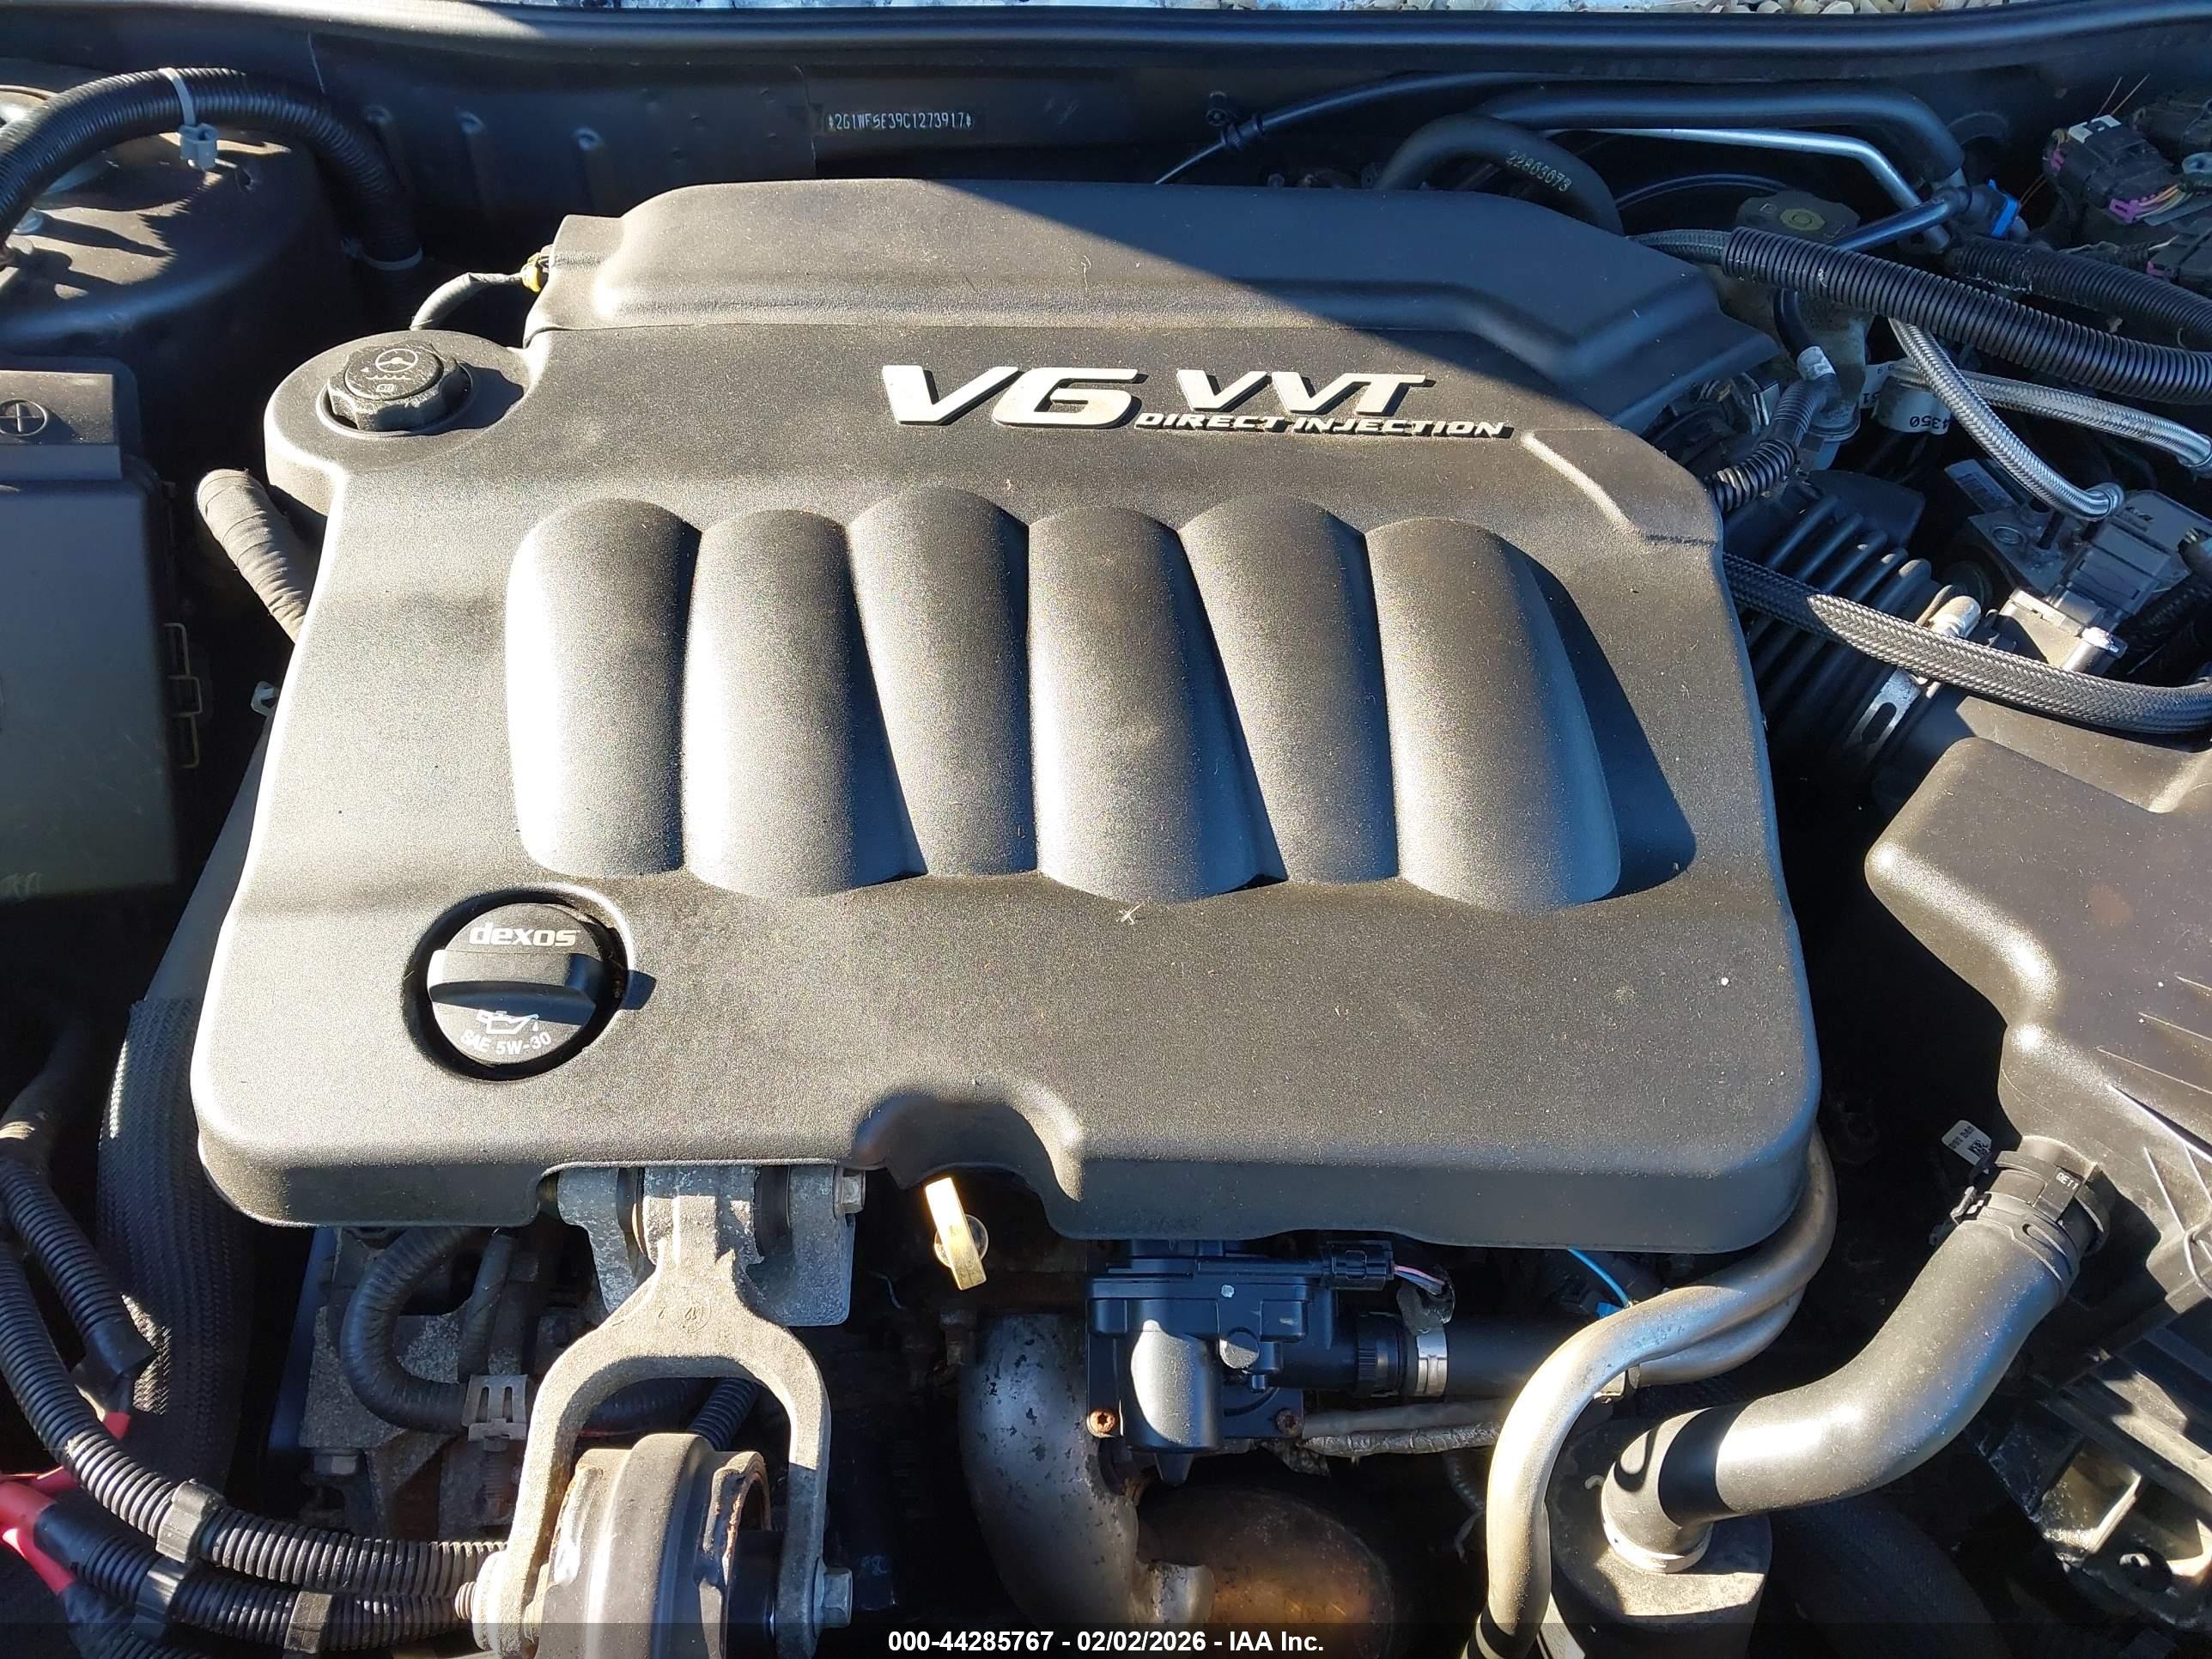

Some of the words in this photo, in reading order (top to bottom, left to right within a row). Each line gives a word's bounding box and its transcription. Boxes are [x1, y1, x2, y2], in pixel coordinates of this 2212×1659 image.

[883, 364, 1140, 428] V6
[1176, 368, 1426, 415] VVT
[1135, 412, 1286, 431] DIRECT
[1292, 417, 1505, 437] INJECTION
[469, 921, 577, 947] dexos
[460, 1030, 492, 1052] SAE
[495, 1030, 551, 1055] 5W-30
